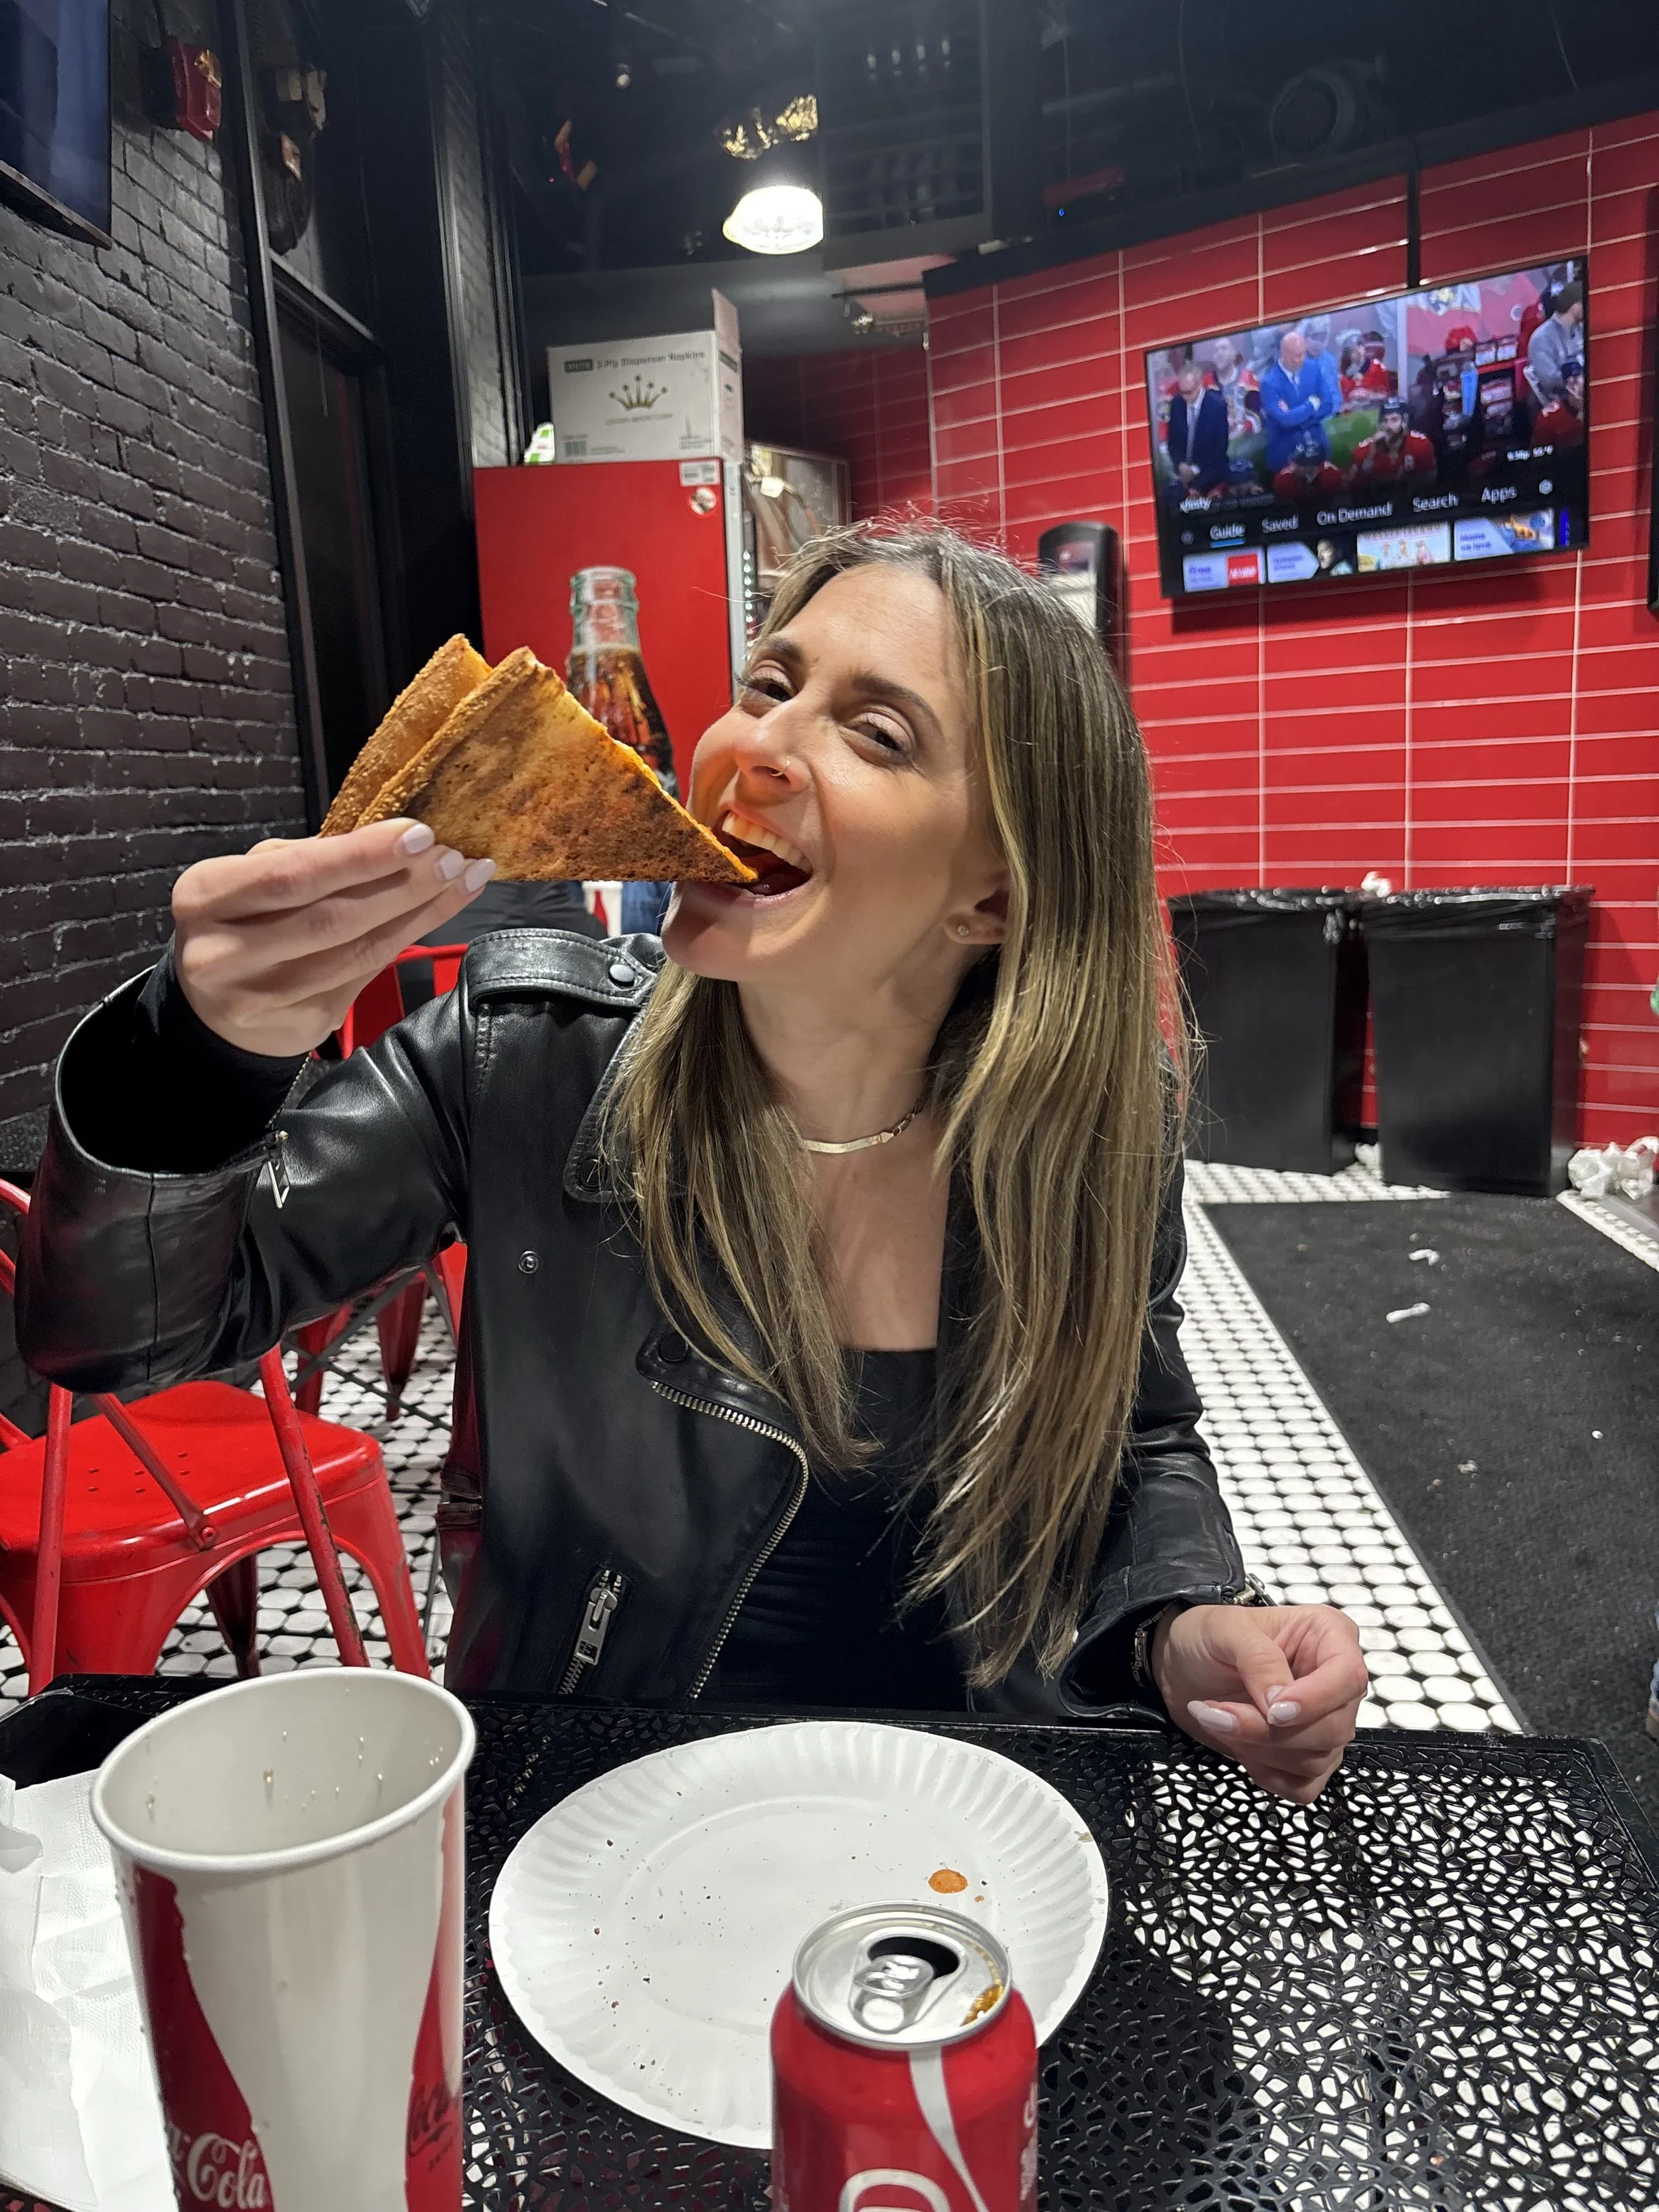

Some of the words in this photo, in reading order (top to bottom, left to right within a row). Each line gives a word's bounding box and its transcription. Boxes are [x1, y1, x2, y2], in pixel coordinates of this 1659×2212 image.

[620, 354, 666, 366] Dispenser
[668, 352, 705, 362] Napkins
[1210, 522, 1246, 540] Guide
[1262, 515, 1299, 533] Saved
[1317, 510, 1337, 526] On
[1338, 500, 1393, 524] Demand
[1412, 491, 1459, 513] Search
[1480, 485, 1518, 504] Apps
